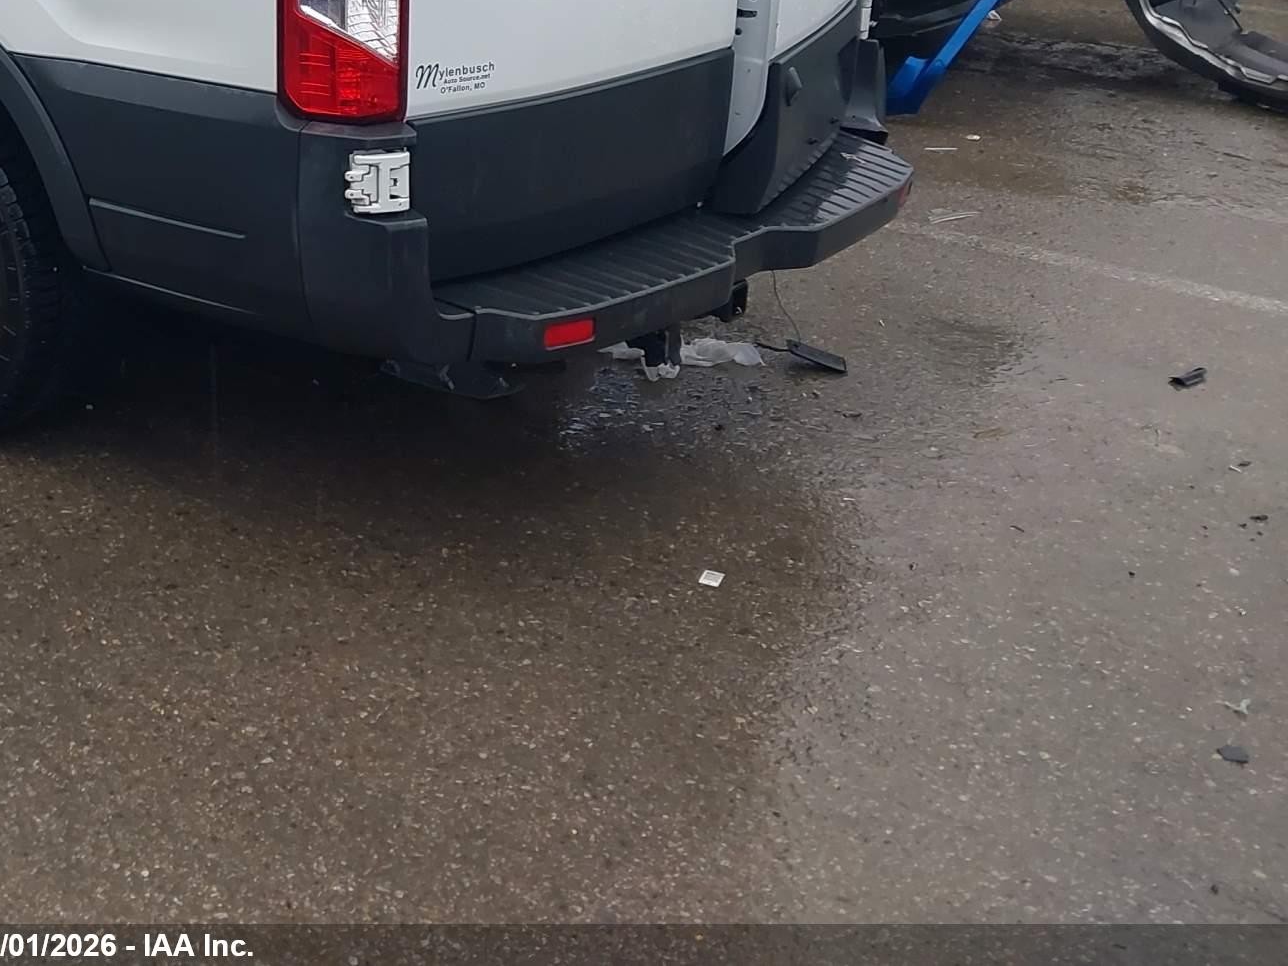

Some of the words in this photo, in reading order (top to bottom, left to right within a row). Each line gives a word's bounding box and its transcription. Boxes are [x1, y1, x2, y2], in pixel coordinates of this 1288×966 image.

[415, 63, 495, 90] Mylenbusch
[440, 84, 472, 94] O'Fallon,
[474, 81, 486, 90] MO
